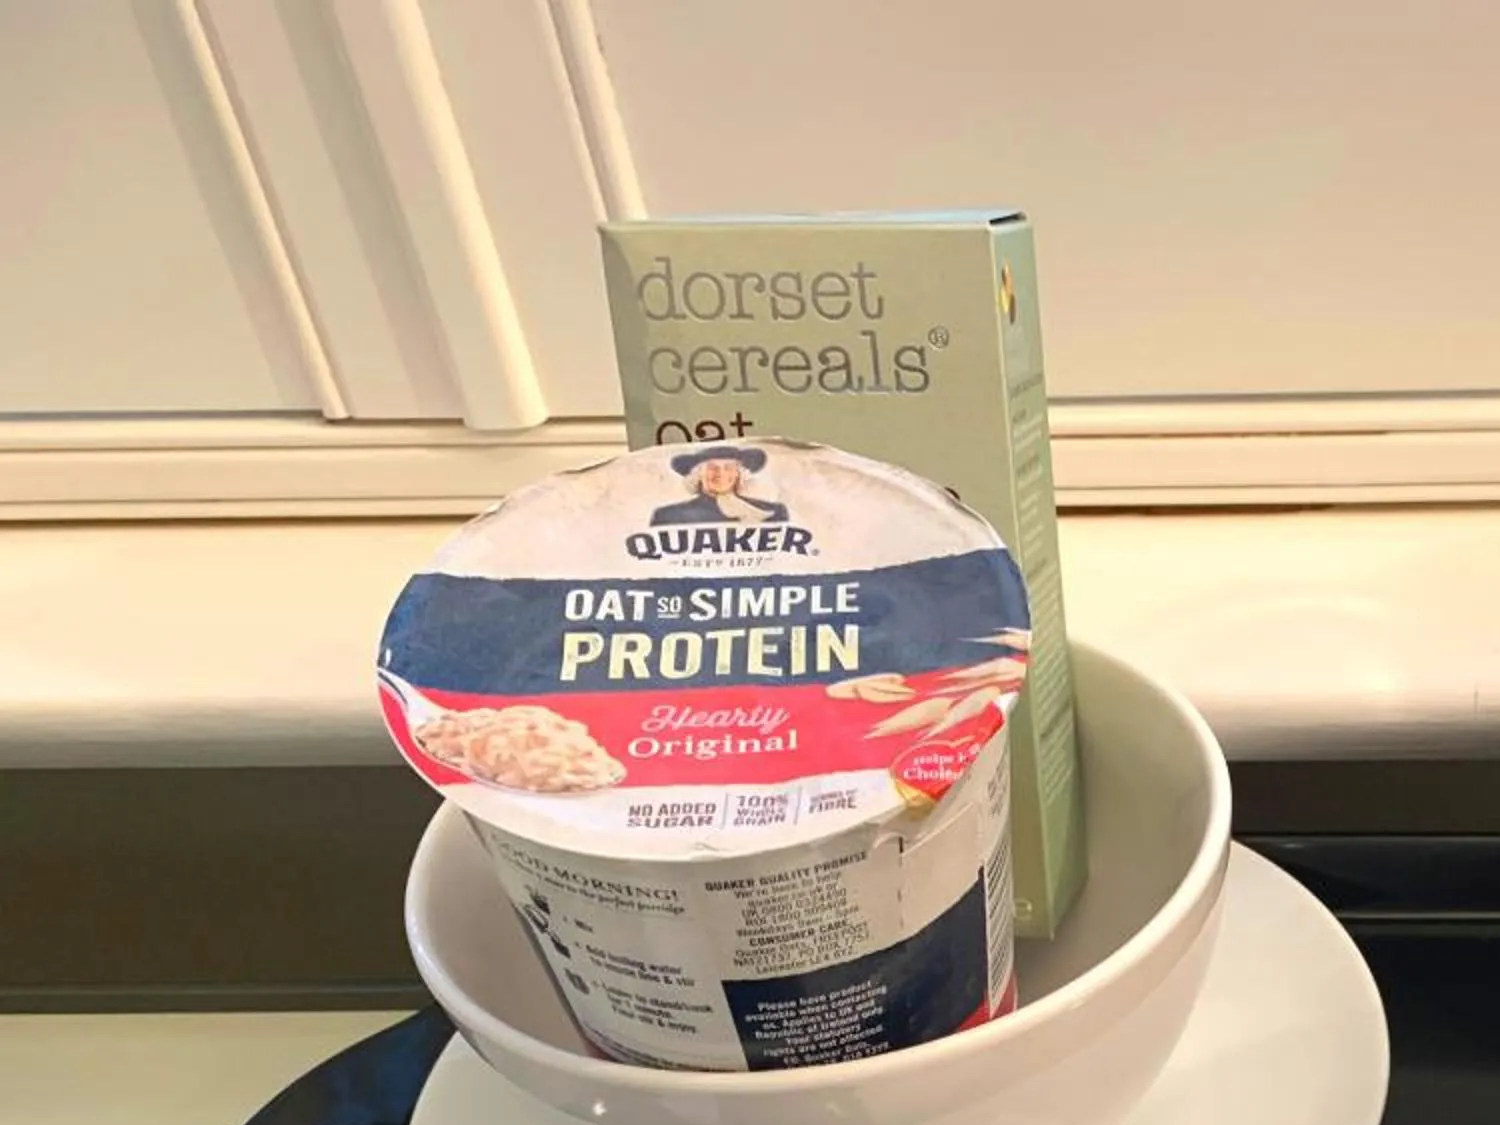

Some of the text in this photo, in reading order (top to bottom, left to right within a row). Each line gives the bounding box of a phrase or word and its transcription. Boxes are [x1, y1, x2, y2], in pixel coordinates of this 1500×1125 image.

[637, 257, 884, 321] dorset
[648, 331, 929, 394] cereals
[625, 526, 814, 561] QUAKER
[564, 588, 655, 622] OAT
[689, 581, 860, 622] SIMPLE
[560, 623, 860, 681] PROTEIN
[642, 704, 791, 734] Hearty
[628, 729, 799, 760] Original
[626, 815, 714, 829] SUGAR
[628, 801, 718, 818] NO ADDED
[704, 851, 868, 892] QUAKER QUALITY PROMISE
